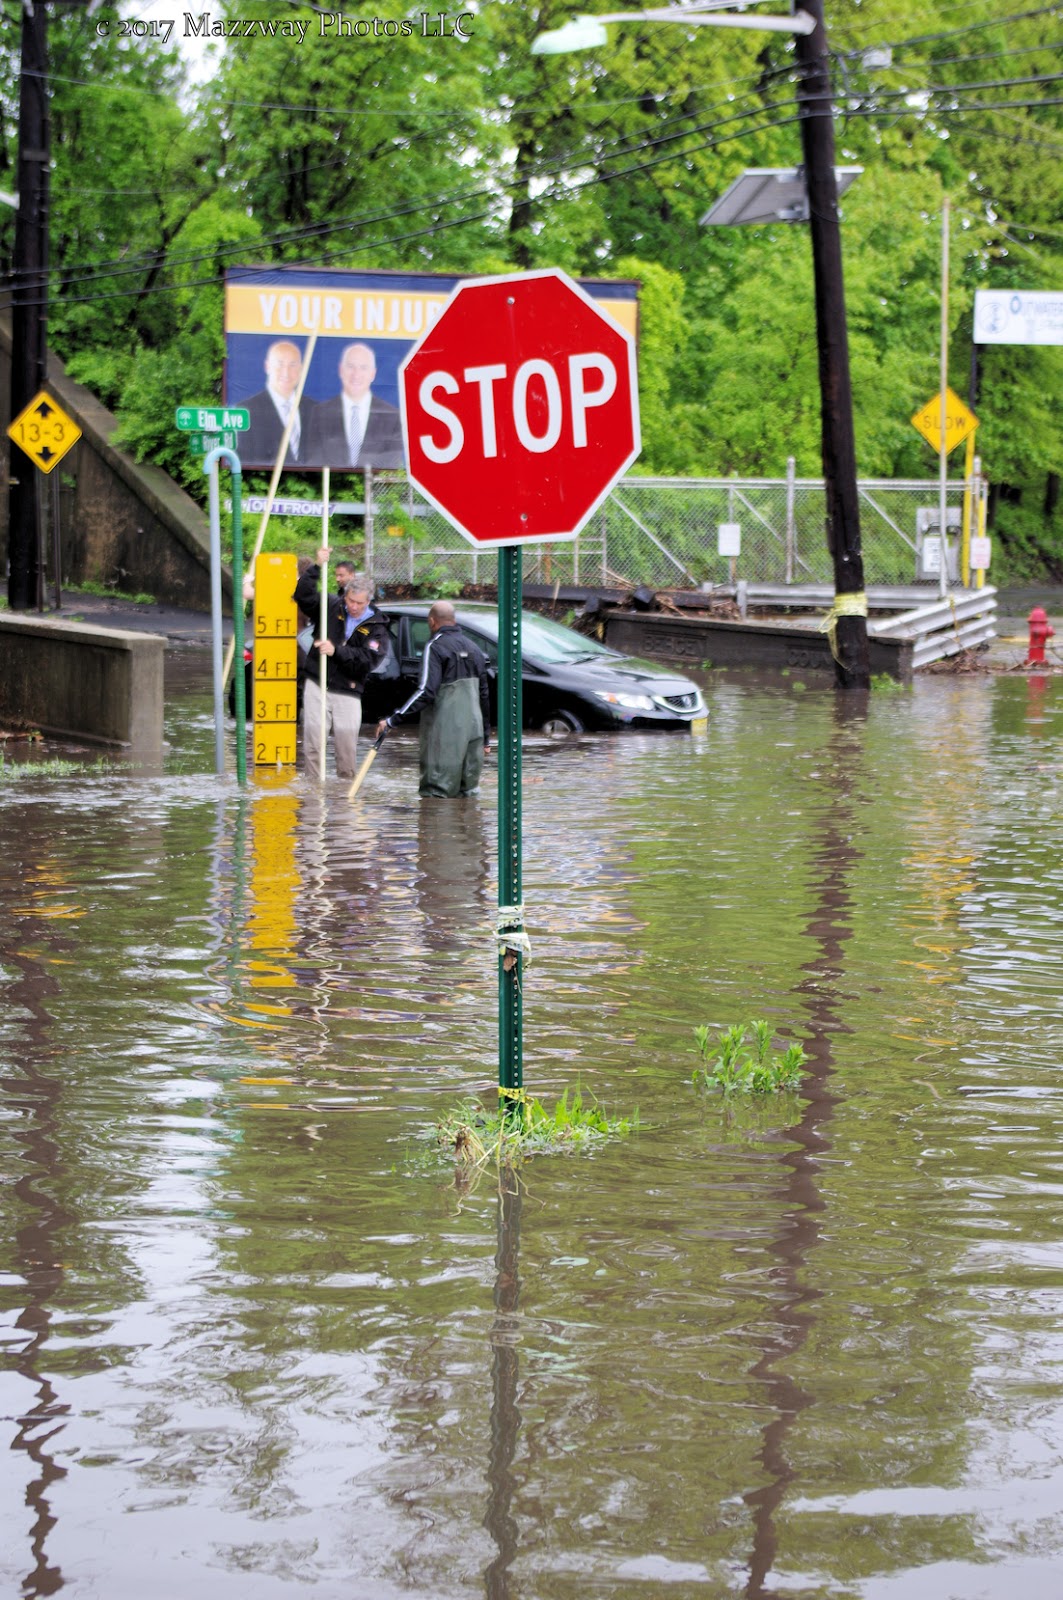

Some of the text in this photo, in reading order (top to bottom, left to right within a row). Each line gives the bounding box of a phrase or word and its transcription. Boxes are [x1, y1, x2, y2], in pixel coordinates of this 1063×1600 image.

[259, 293, 343, 329] YOUR
[418, 351, 618, 464] STOP
[198, 410, 243, 429] Elm Ave
[923, 415, 966, 430] SLOW
[224, 432, 234, 449] Rd
[257, 616, 266, 634] 5
[257, 659, 268, 677] 4
[257, 700, 266, 719] 3
[257, 743, 266, 761] 2
